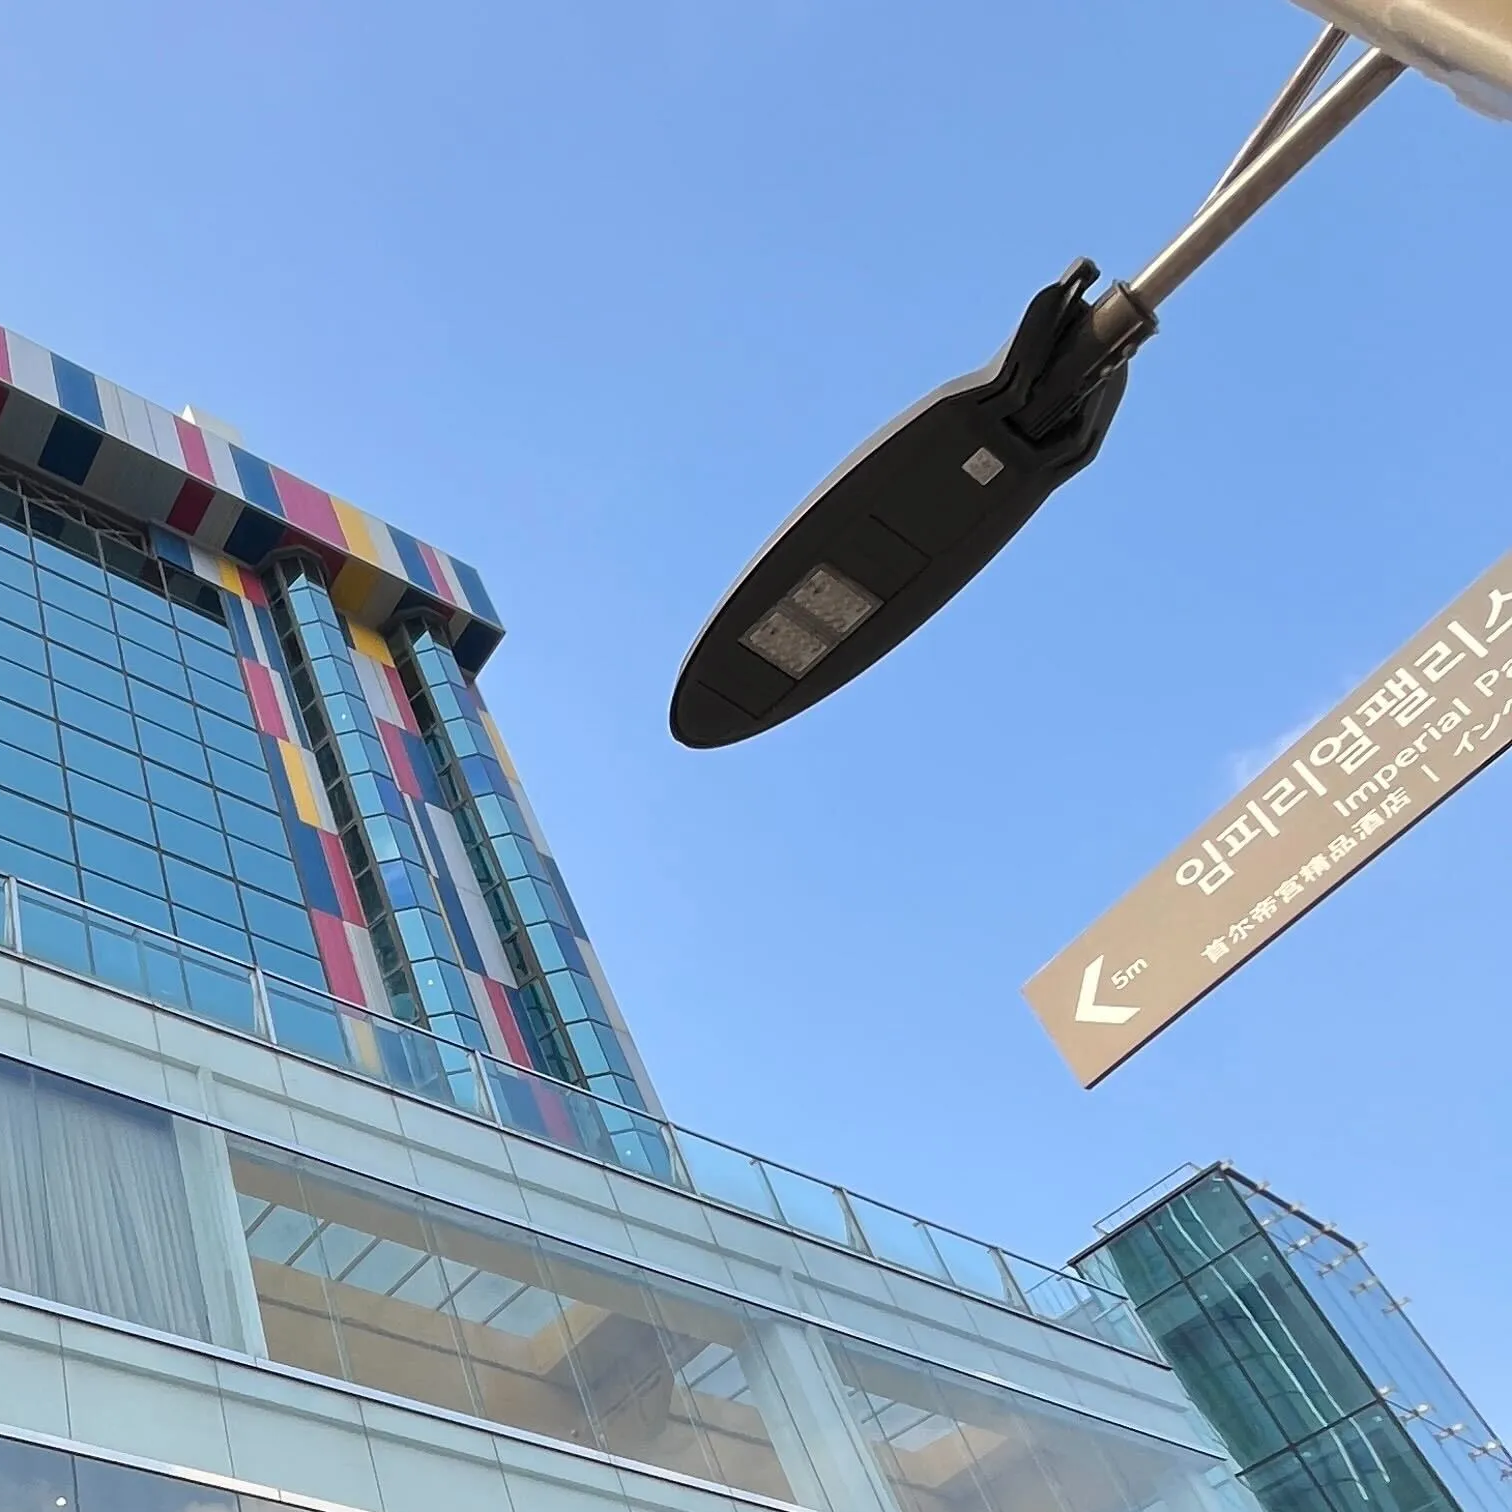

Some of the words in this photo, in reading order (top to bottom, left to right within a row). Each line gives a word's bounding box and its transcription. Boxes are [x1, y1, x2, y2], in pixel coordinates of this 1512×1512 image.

[1333, 697, 1472, 817] Imperial
[1200, 786, 1412, 964] 首尔帝宫精品酒店
[1110, 956, 1149, 991] 5m
